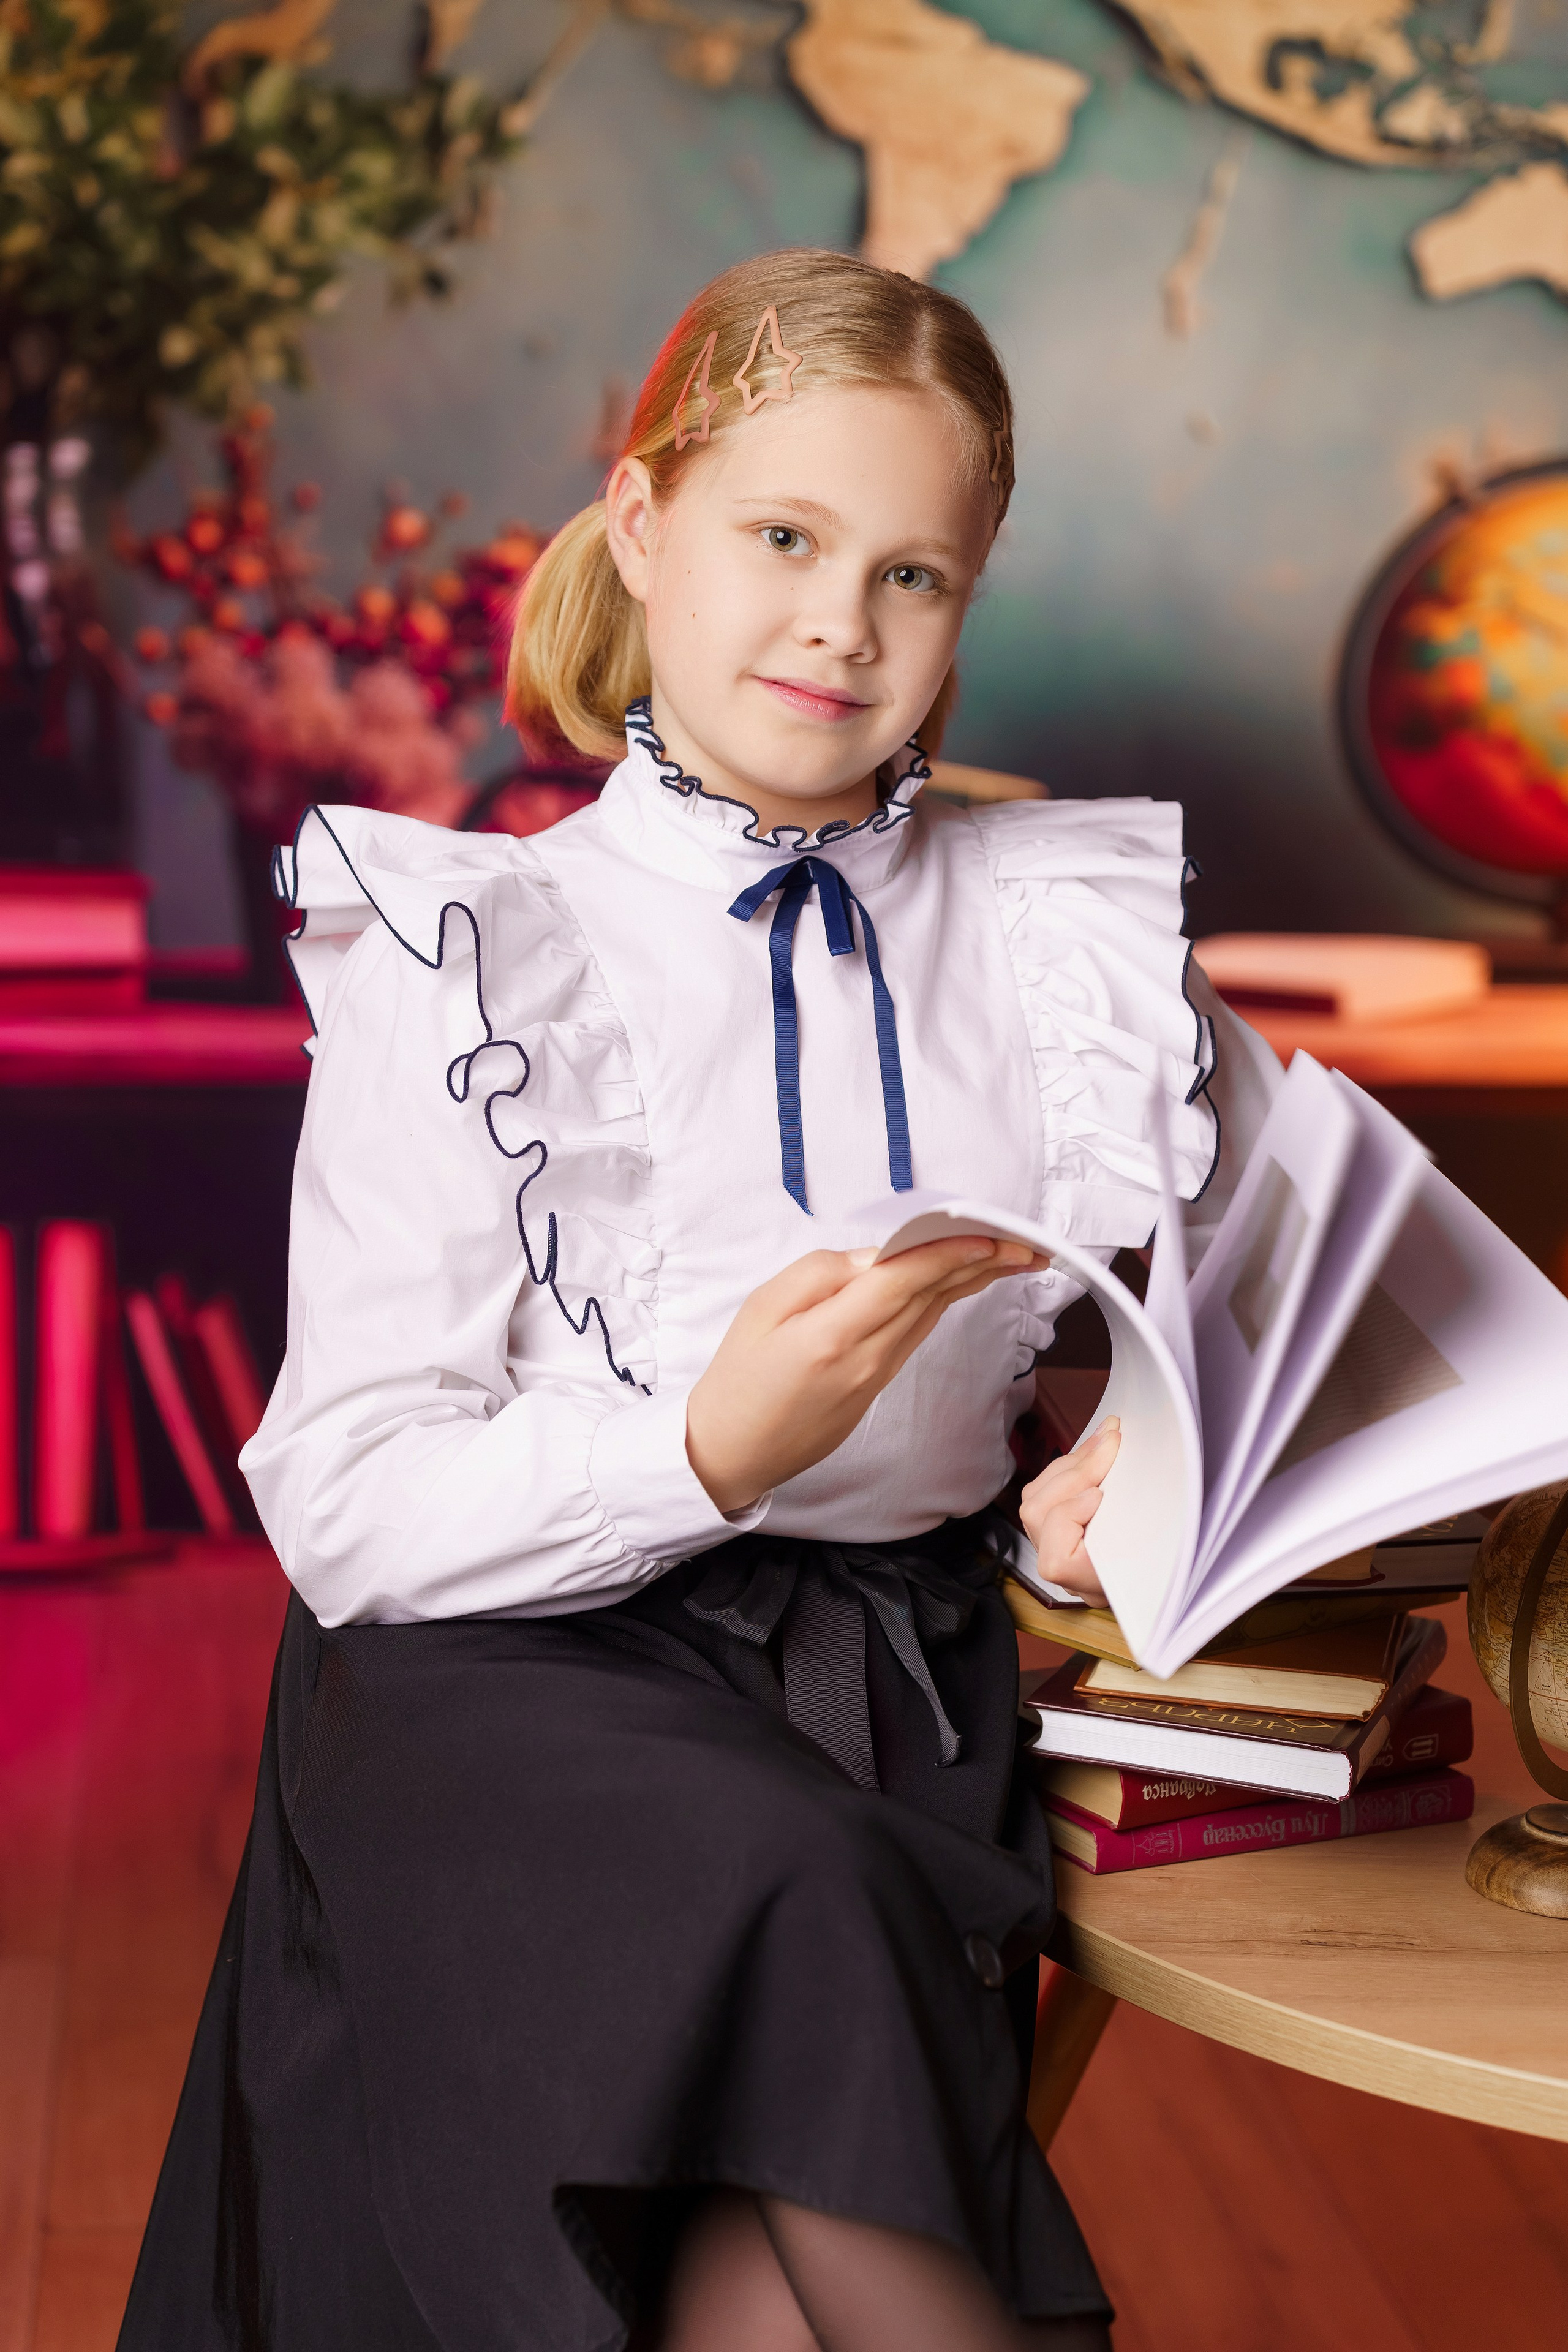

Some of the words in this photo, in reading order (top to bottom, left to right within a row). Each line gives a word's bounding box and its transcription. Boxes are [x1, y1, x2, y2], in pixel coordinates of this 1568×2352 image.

[1098, 1697, 1297, 1733] ЧАРЛЬЗ
[1202, 1815, 1286, 1846] Буссенар
[1290, 1810, 1329, 1838] Луи
